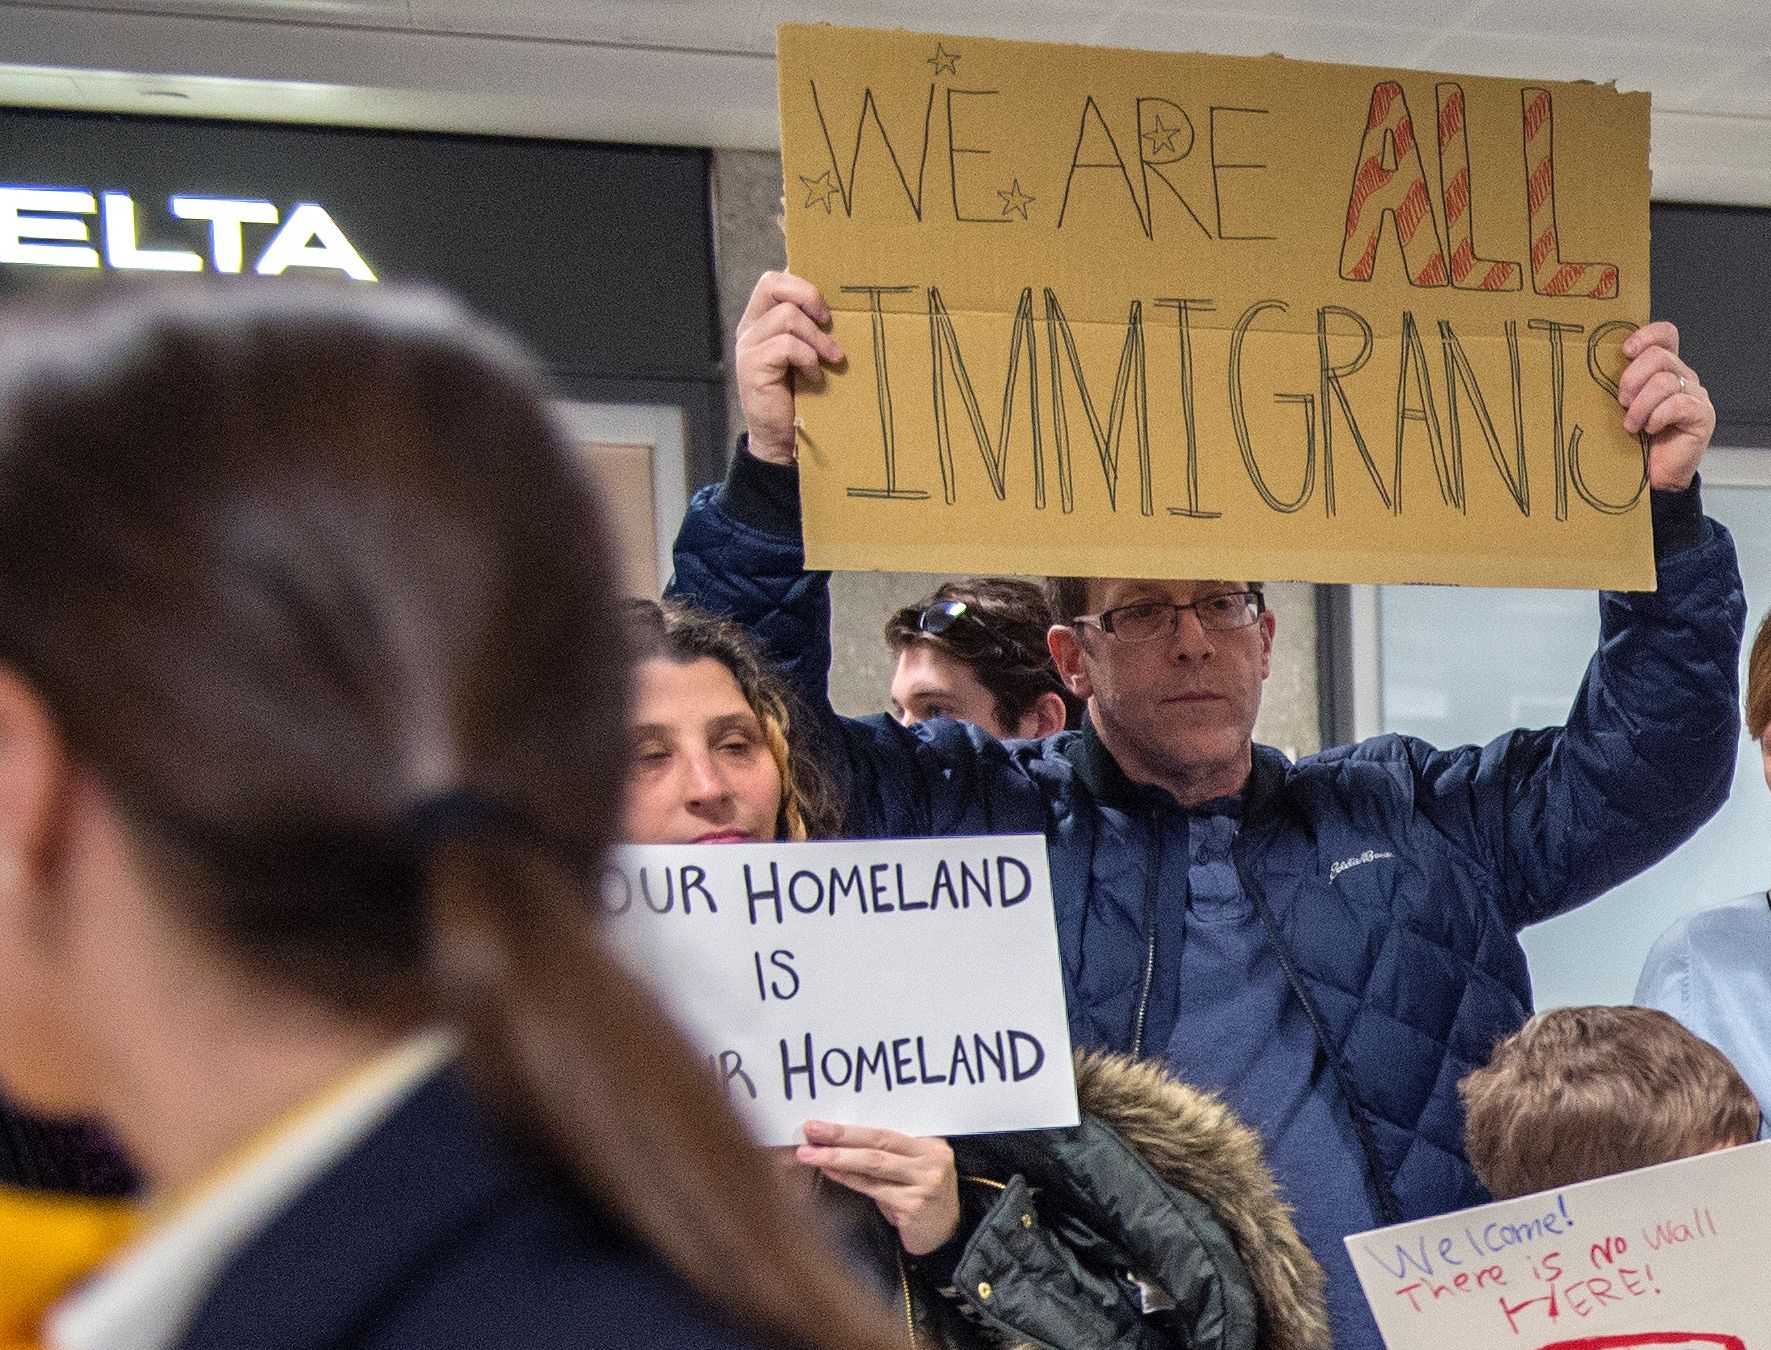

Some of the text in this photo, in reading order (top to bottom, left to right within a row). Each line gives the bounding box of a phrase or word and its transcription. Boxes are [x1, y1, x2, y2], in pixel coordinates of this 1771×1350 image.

[809, 80, 1619, 298] WE ARE ALL
[839, 284, 1650, 521] IMMIGRANTS
[743, 856, 1032, 925] HOMELAND
[754, 949, 800, 1001] IS
[779, 1029, 1046, 1102] HOMELAND
[1364, 1194, 1574, 1280] Welcome!
[1499, 1263, 1662, 1334] HERE!
